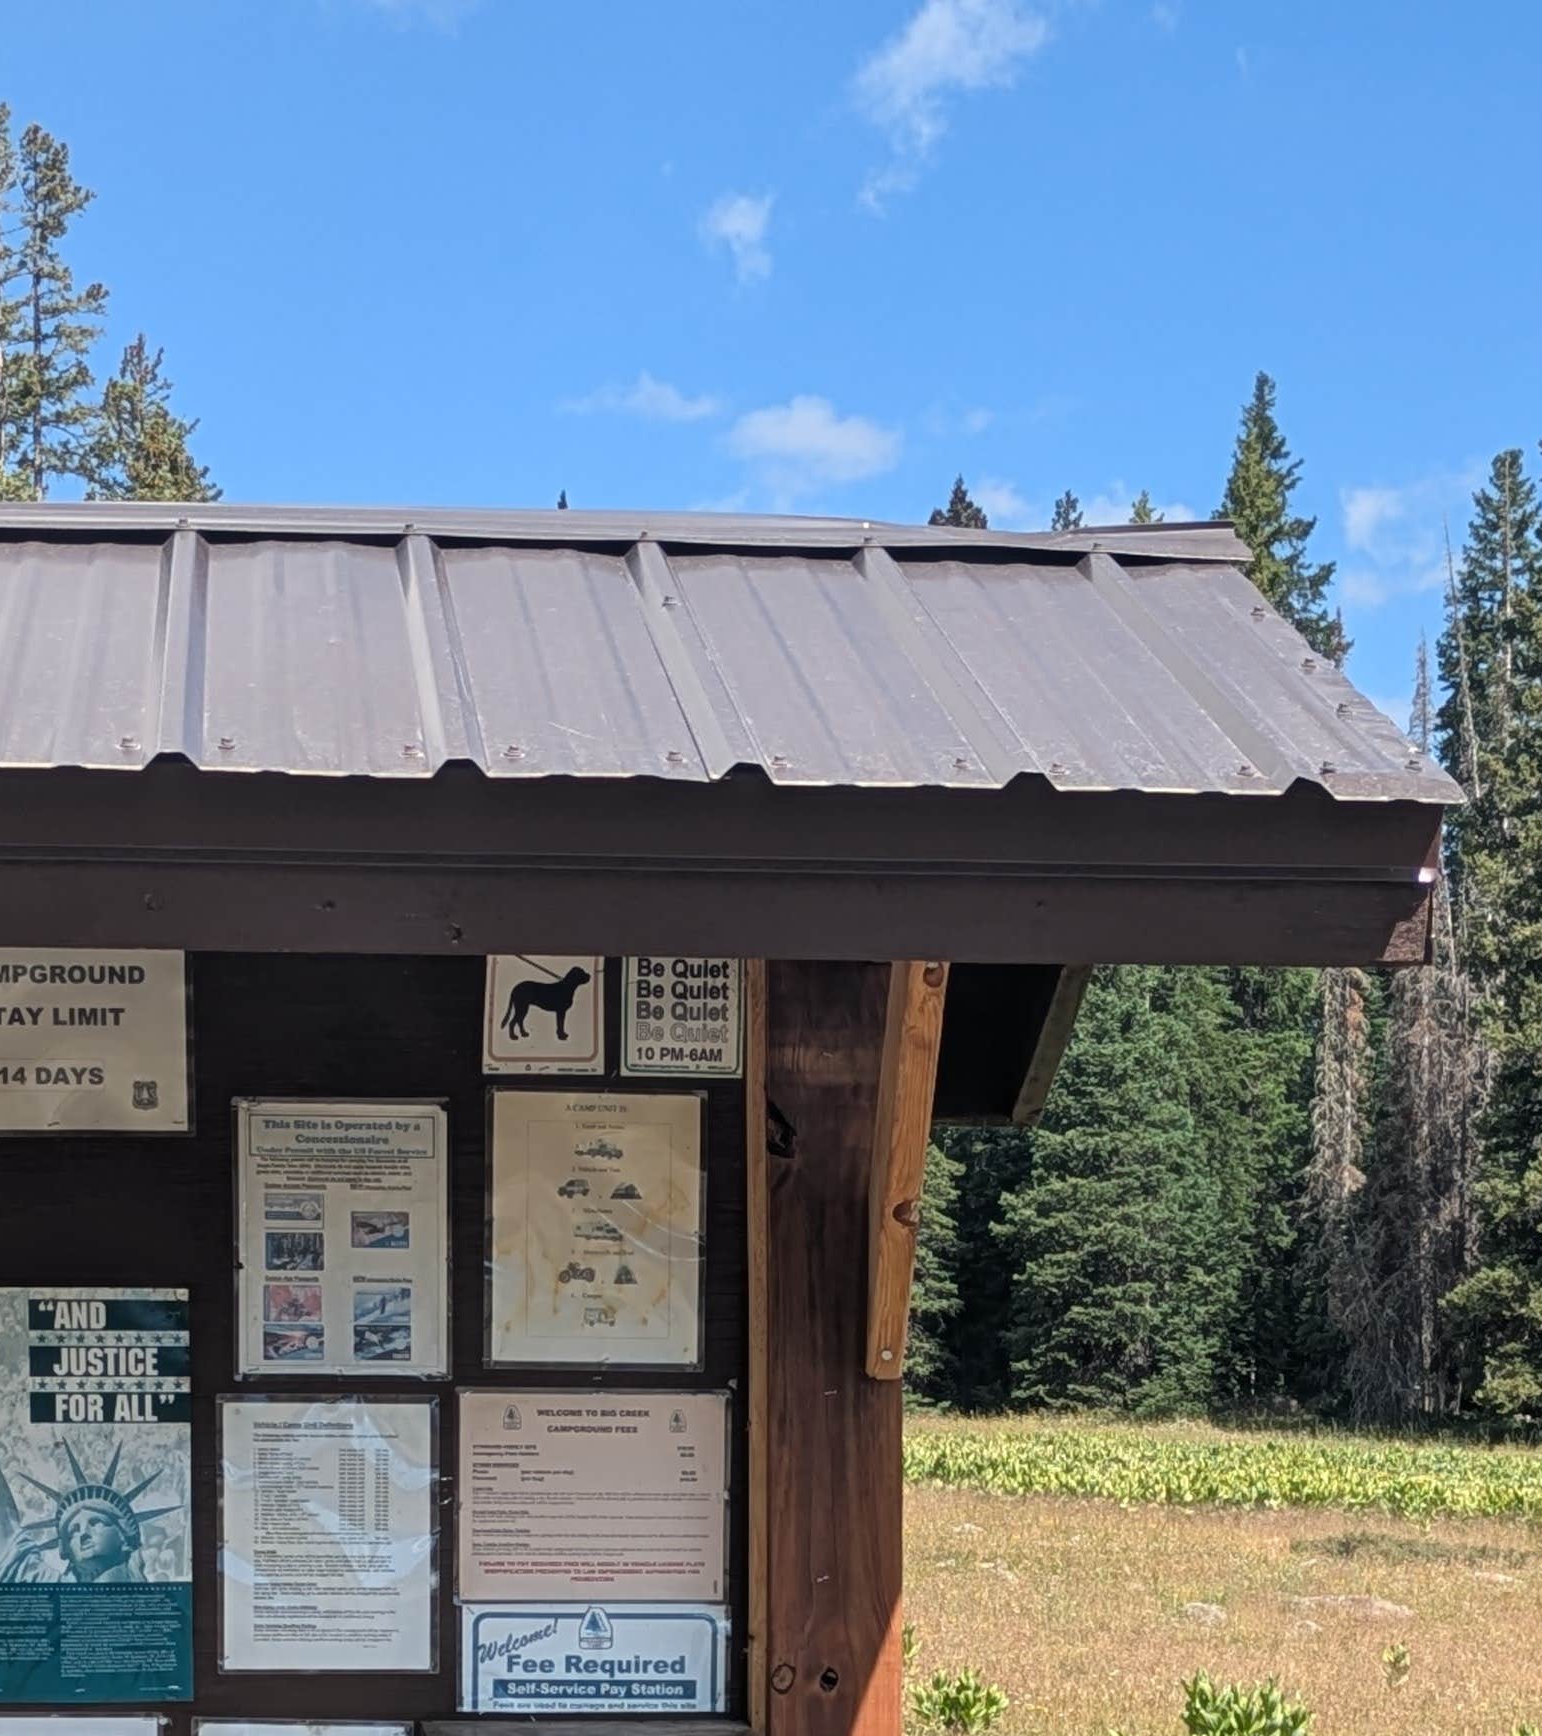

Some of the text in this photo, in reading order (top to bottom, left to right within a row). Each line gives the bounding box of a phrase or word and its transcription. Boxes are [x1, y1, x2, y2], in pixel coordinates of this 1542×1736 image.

[637, 958, 729, 979] Be Quiet
[637, 979, 729, 1000] Be Quiet
[53, 1007, 125, 1027] LIMIT
[637, 1000, 728, 1022] Be Quiet
[636, 1021, 728, 1043] Be Quiet
[637, 1047, 722, 1062] 10 PM-6AM
[35, 1067, 104, 1086] DAYS
[263, 1120, 291, 1130] This
[294, 1121, 317, 1130] Site
[321, 1121, 331, 1131] is
[334, 1121, 392, 1132] Operated
[395, 1121, 411, 1133] by
[295, 1134, 389, 1145] Concessionaire
[39, 1301, 106, 1329] “AND
[53, 1347, 159, 1377] JUSTICE
[55, 1395, 104, 1423] FOR
[479, 1617, 558, 1664] Welcome!
[507, 1655, 685, 1678] Fee Required
[507, 1683, 683, 1698] Self-Service Pay Station
[569, 1703, 604, 1711] manage
[627, 1702, 658, 1710] service
[680, 1702, 696, 1710] site
